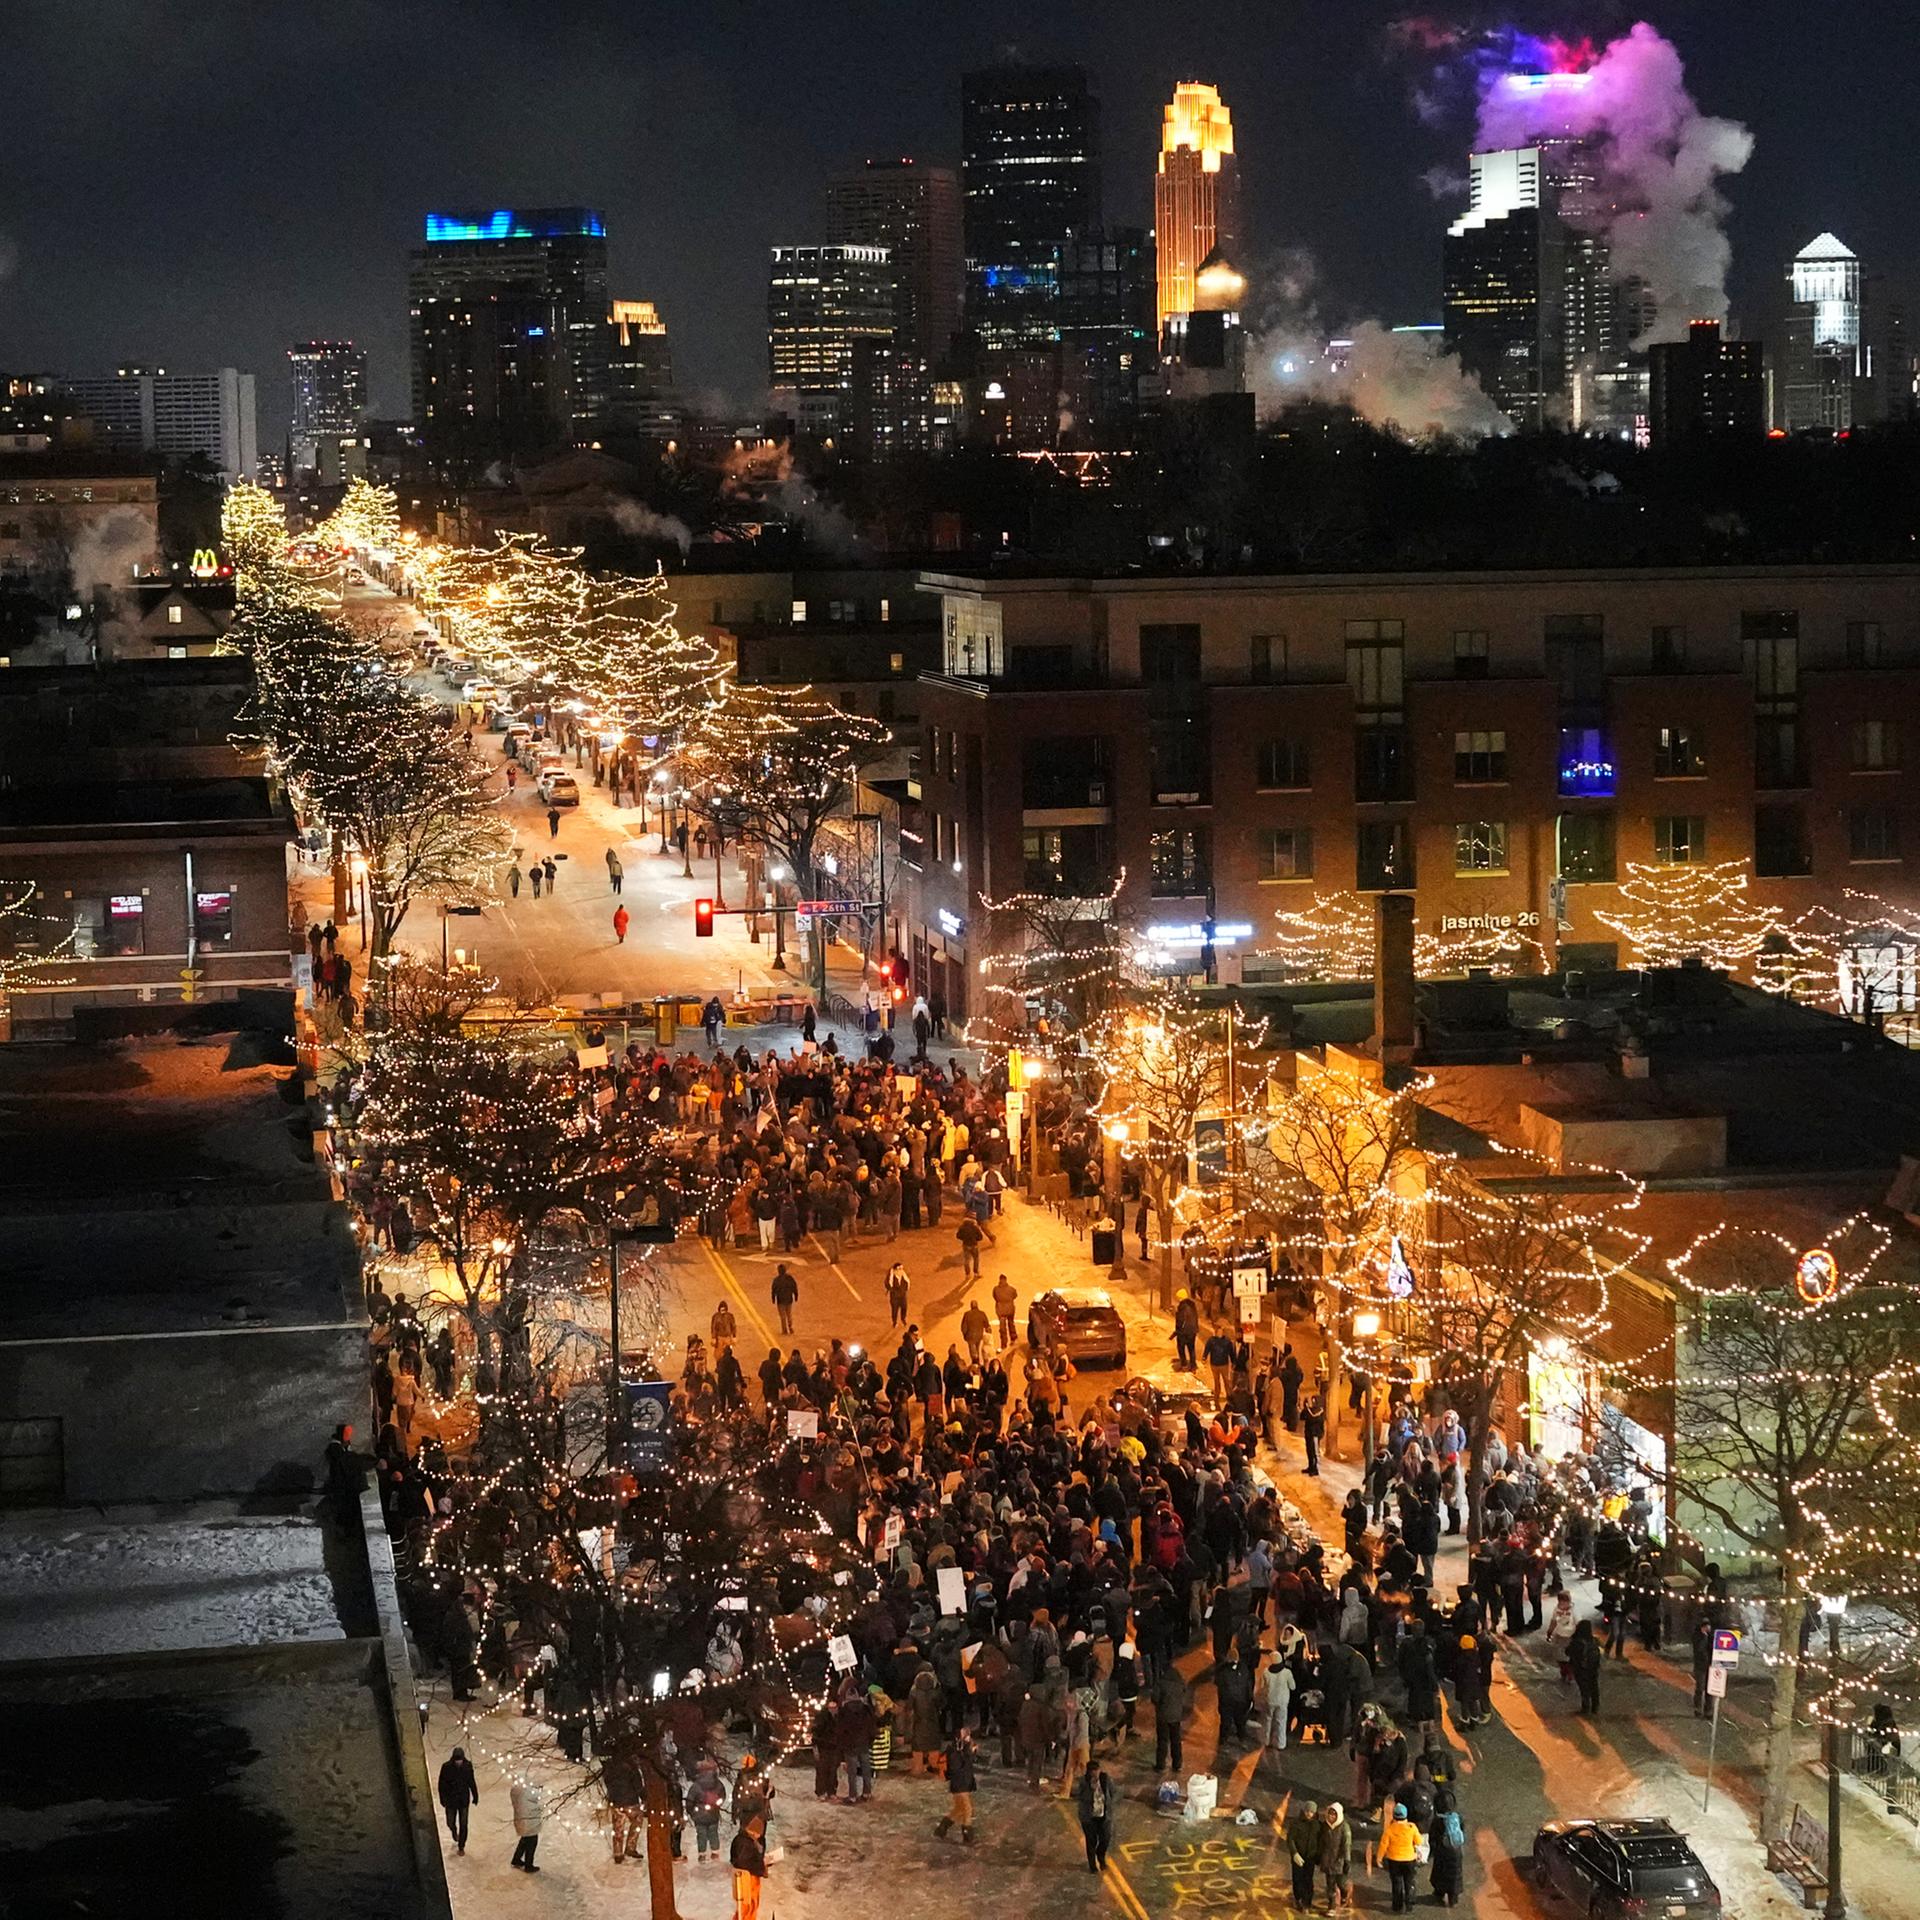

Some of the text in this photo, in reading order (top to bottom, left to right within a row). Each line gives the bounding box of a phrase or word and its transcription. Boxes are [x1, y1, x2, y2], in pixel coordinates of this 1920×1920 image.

[822, 903, 846, 912] 26th
[849, 903, 860, 912] St
[1441, 912, 1540, 933] jasmine 26
[1119, 1837, 1266, 1862] FUCK
[1154, 1856, 1258, 1876] ICE
